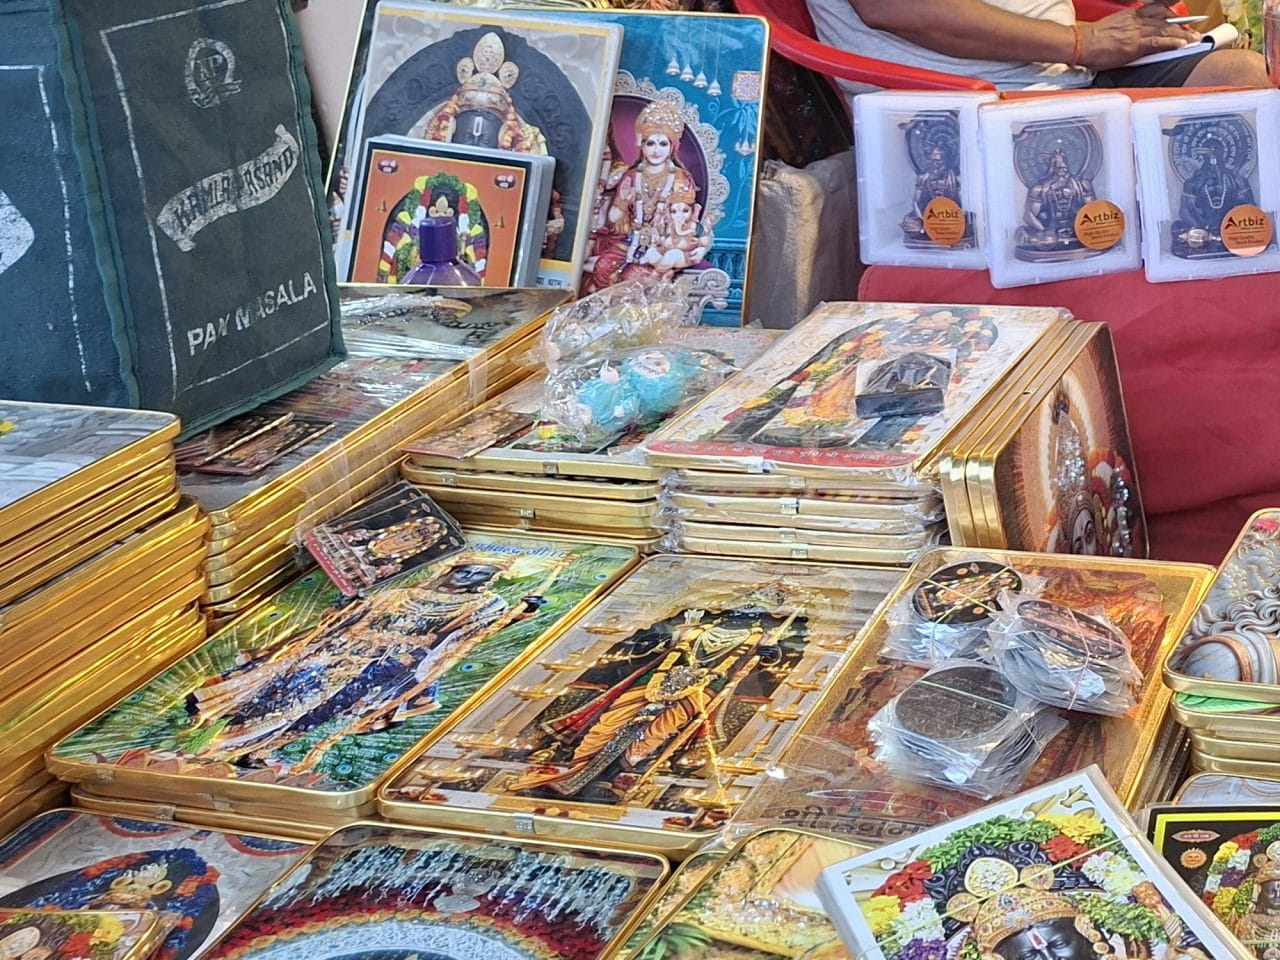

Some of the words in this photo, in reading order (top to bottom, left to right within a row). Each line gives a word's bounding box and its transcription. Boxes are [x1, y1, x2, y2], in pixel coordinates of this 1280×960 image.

[927, 208, 960, 220] Artbiz
[1079, 210, 1121, 227] Artbiz
[1224, 216, 1266, 230] Artbiz
[187, 312, 231, 356] PAN
[235, 271, 317, 333] MASALA
